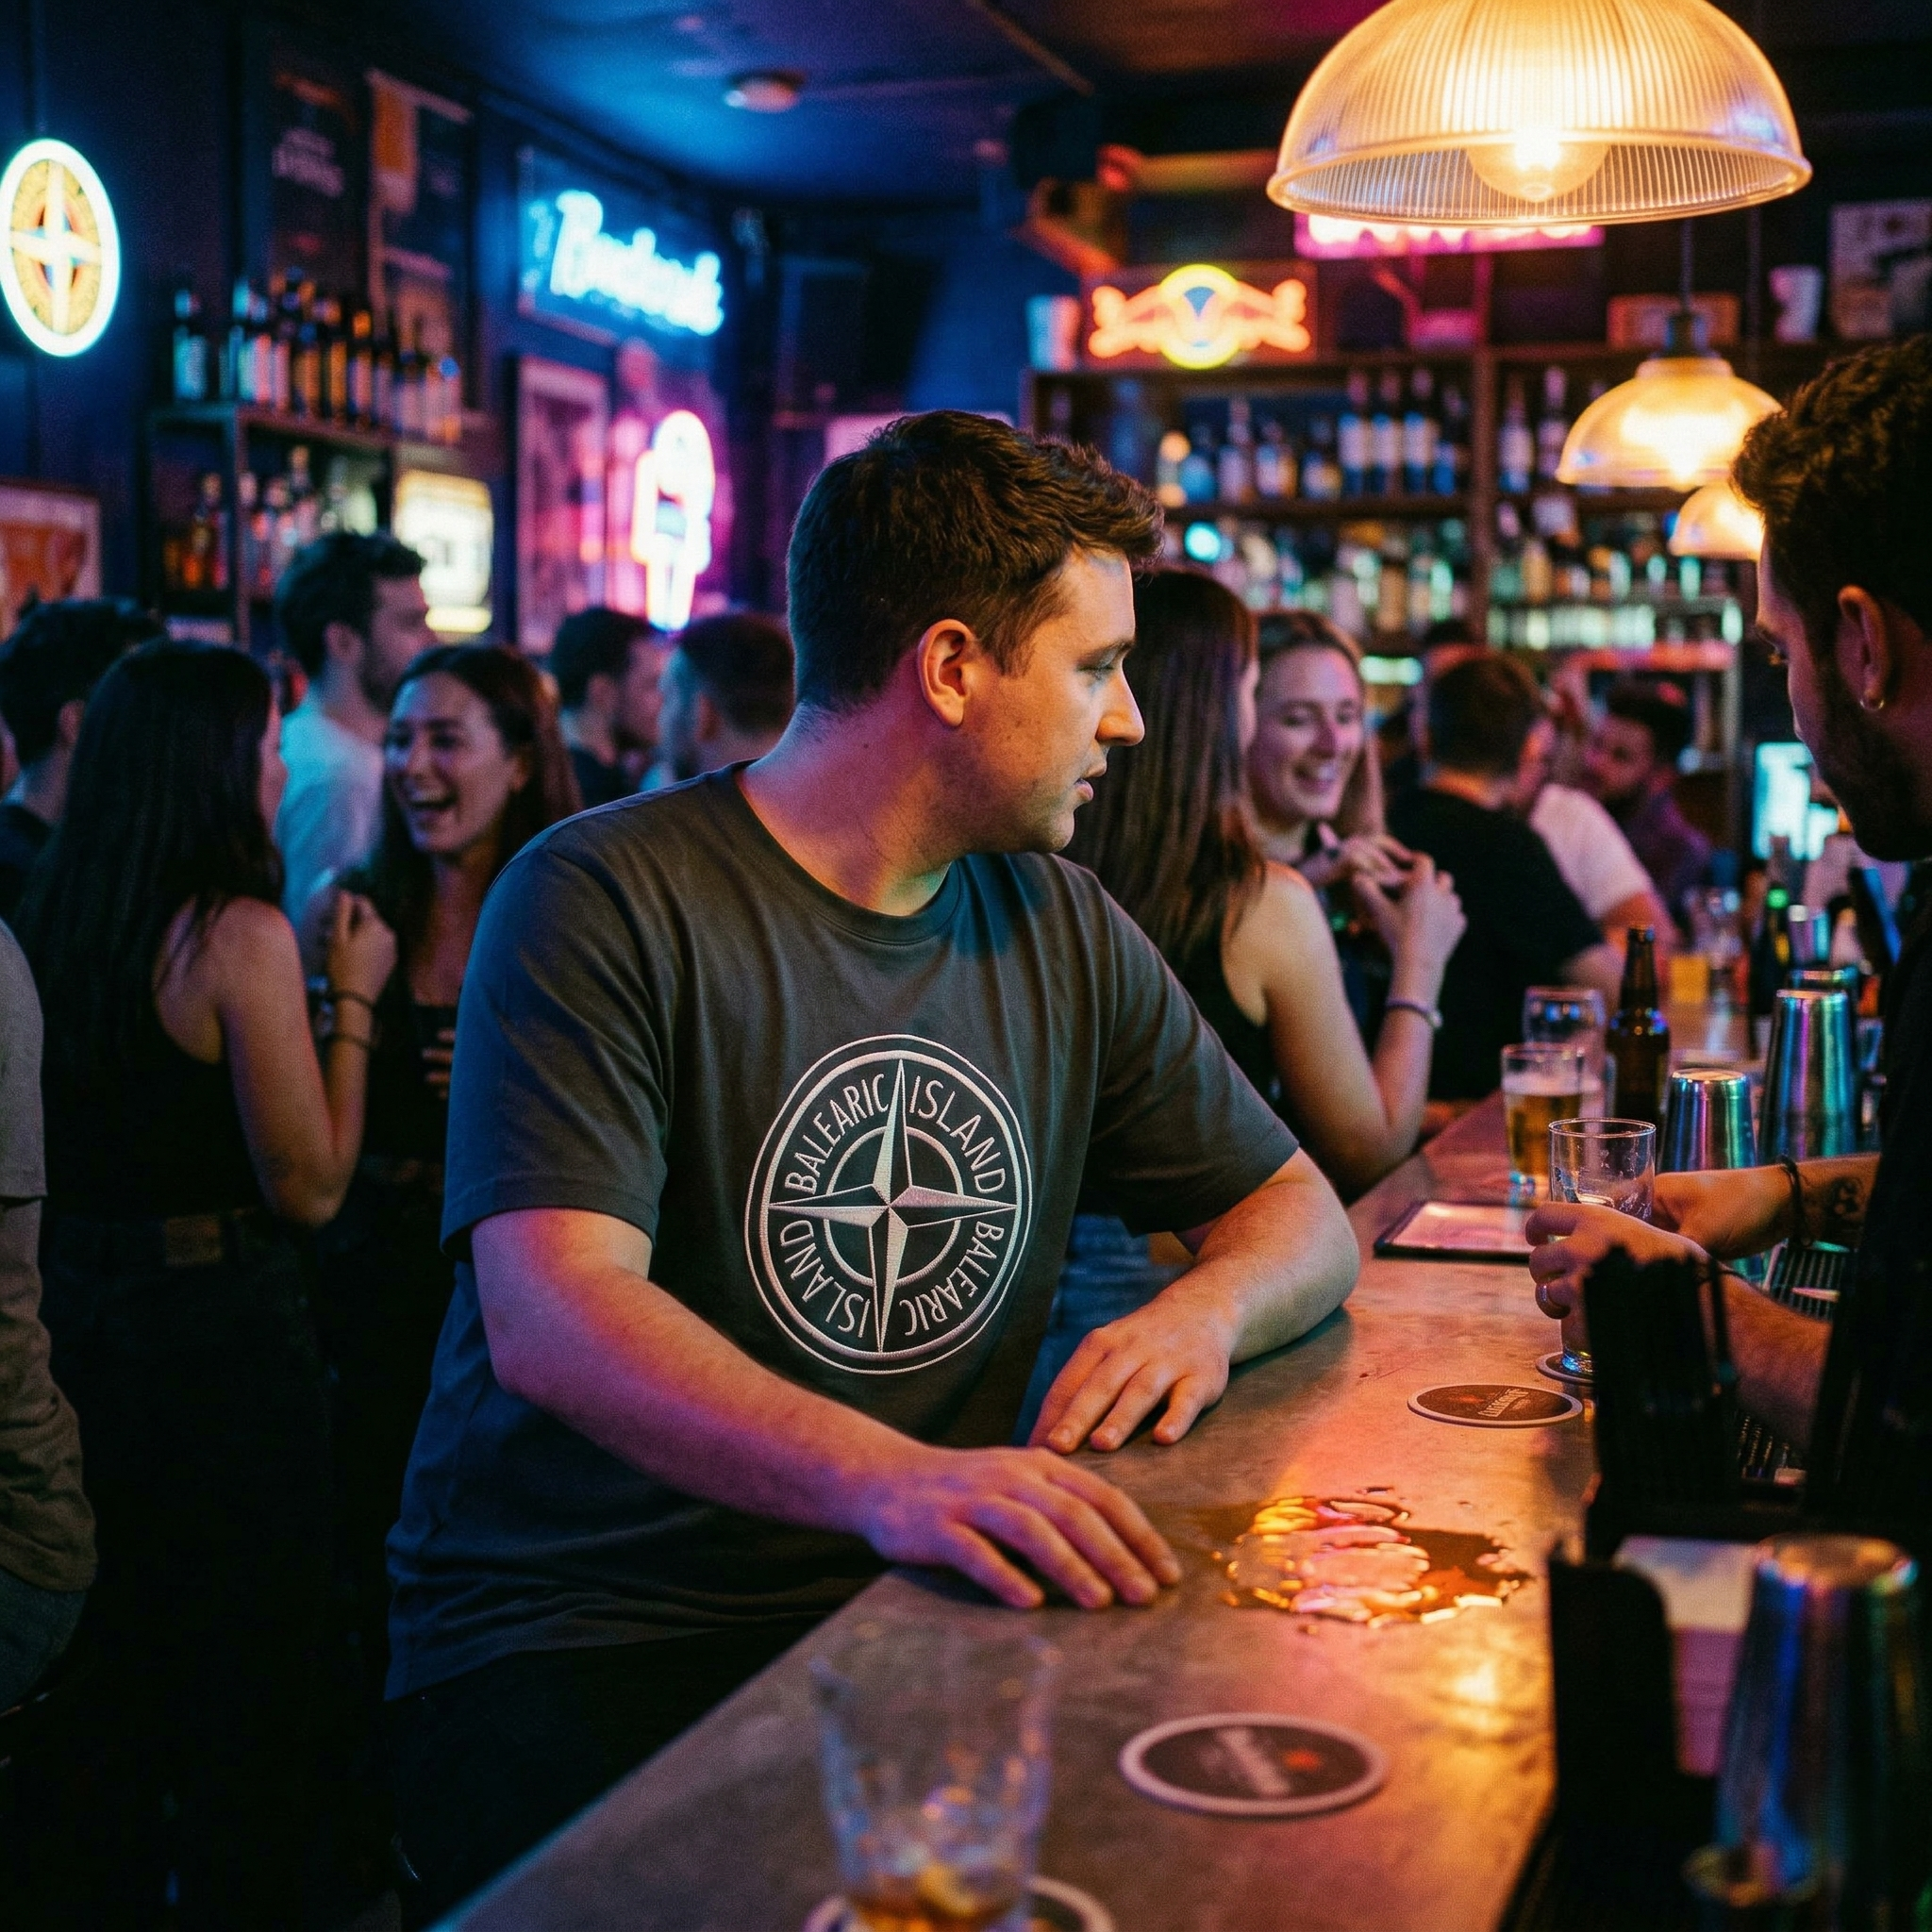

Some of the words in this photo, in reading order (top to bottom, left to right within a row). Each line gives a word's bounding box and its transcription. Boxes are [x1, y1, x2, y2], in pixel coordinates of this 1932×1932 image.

[784, 1073, 889, 1194] BALEARIC
[909, 1075, 1006, 1194] ISLAND
[779, 1219, 871, 1338] ISLAND
[899, 1221, 1005, 1337] BALEARIC
